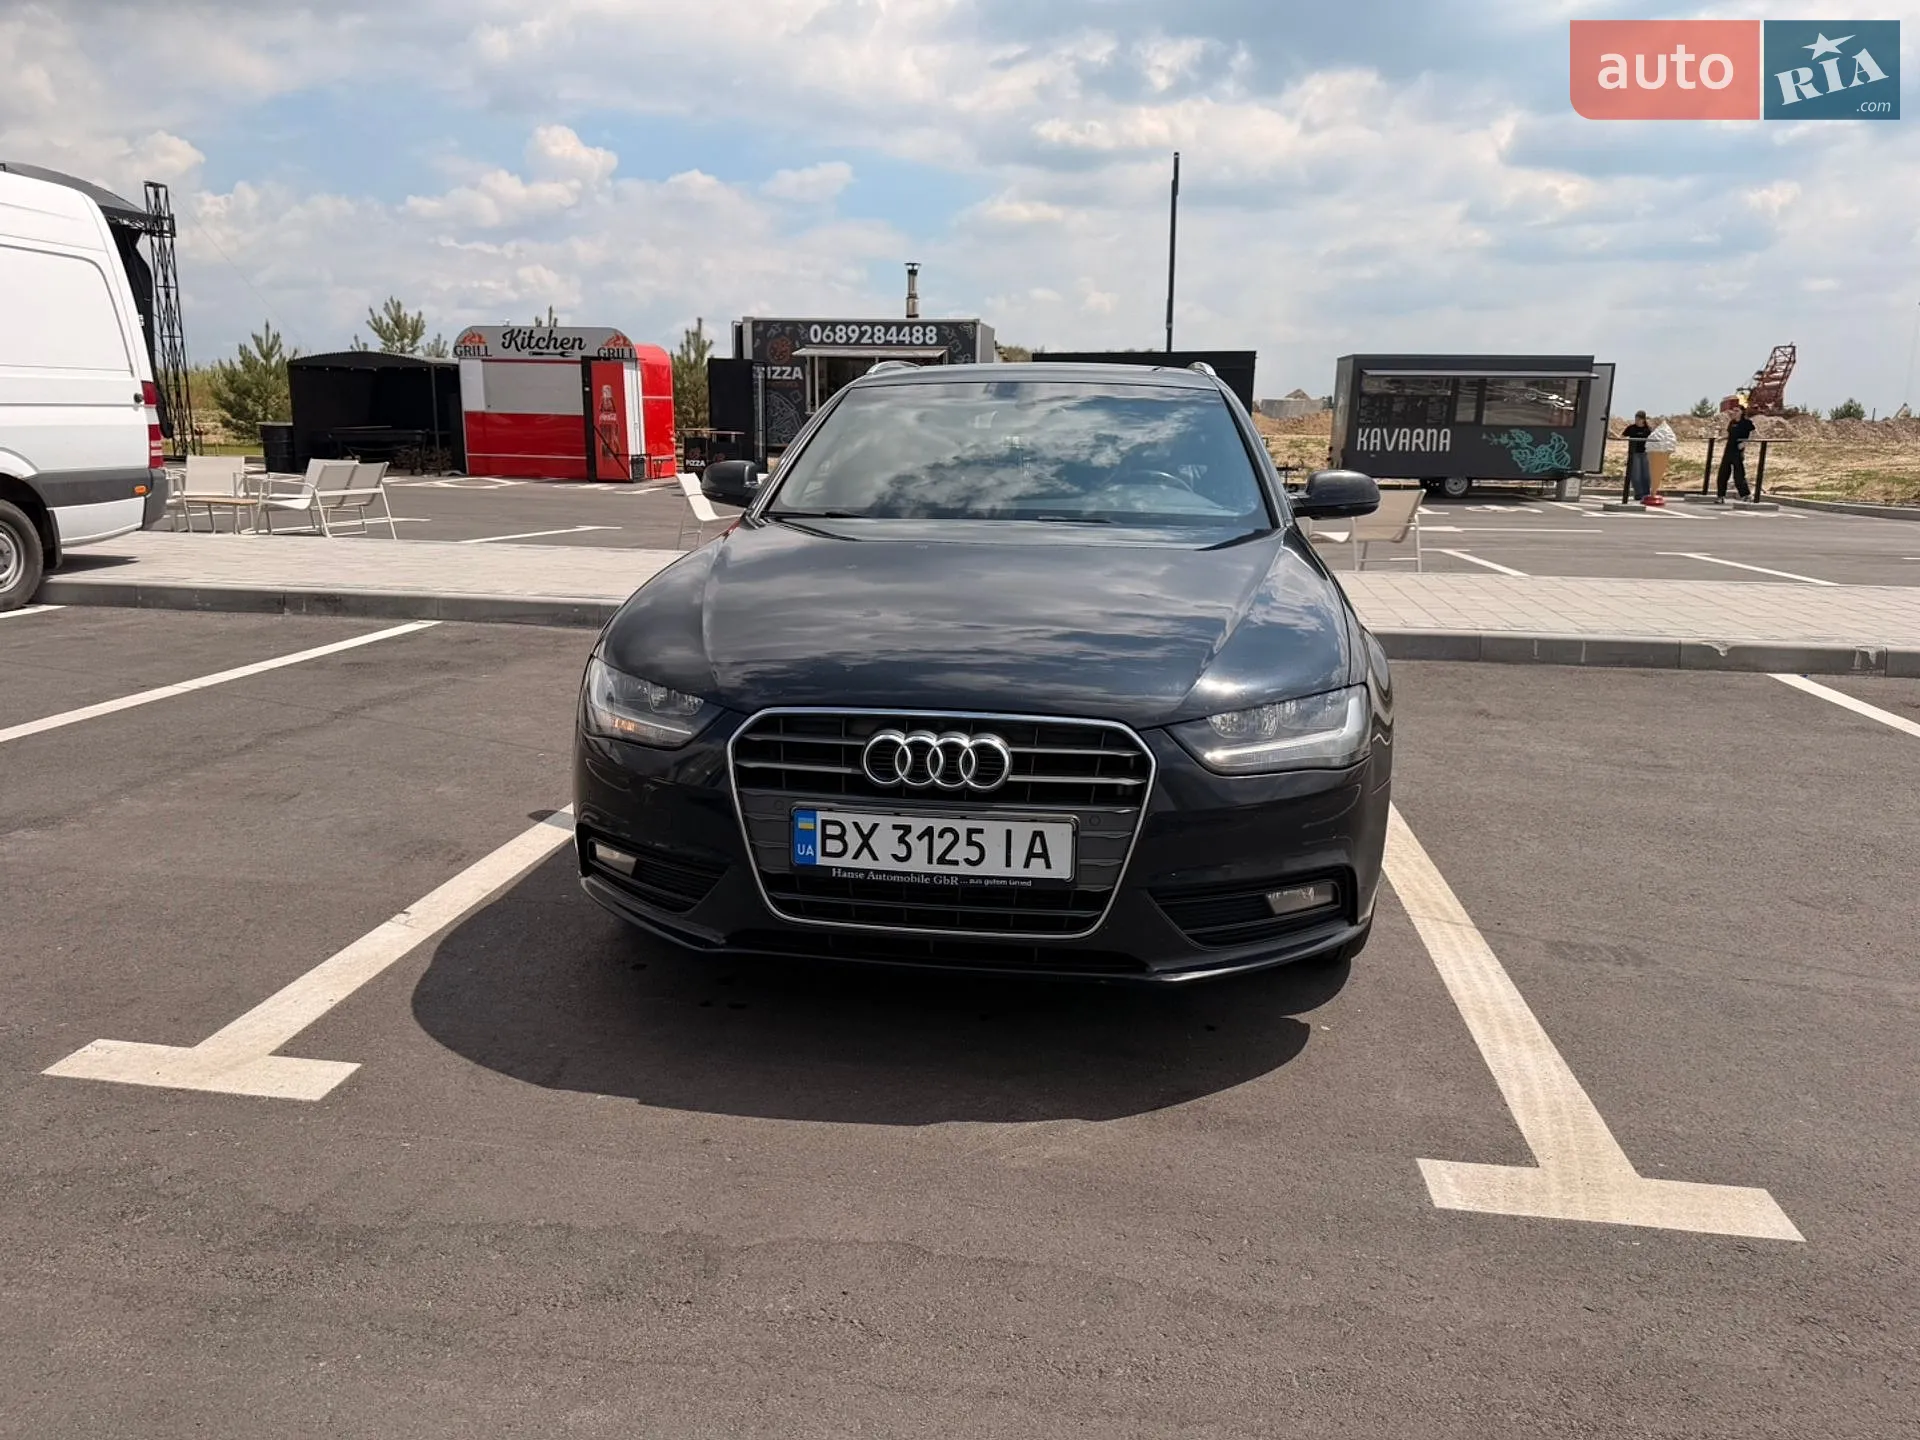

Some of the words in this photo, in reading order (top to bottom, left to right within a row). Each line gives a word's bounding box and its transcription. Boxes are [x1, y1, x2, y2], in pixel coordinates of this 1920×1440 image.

[501, 328, 587, 352] Kitchen
[809, 324, 938, 345] 0689284488
[453, 345, 493, 357] GRILL
[797, 843, 814, 857] UA
[820, 819, 881, 862] BX
[891, 824, 986, 867] 3125
[1005, 828, 1052, 870] IA
[831, 867, 865, 880] Hanse
[867, 871, 931, 884] Automobile
[933, 875, 959, 886] GbR
